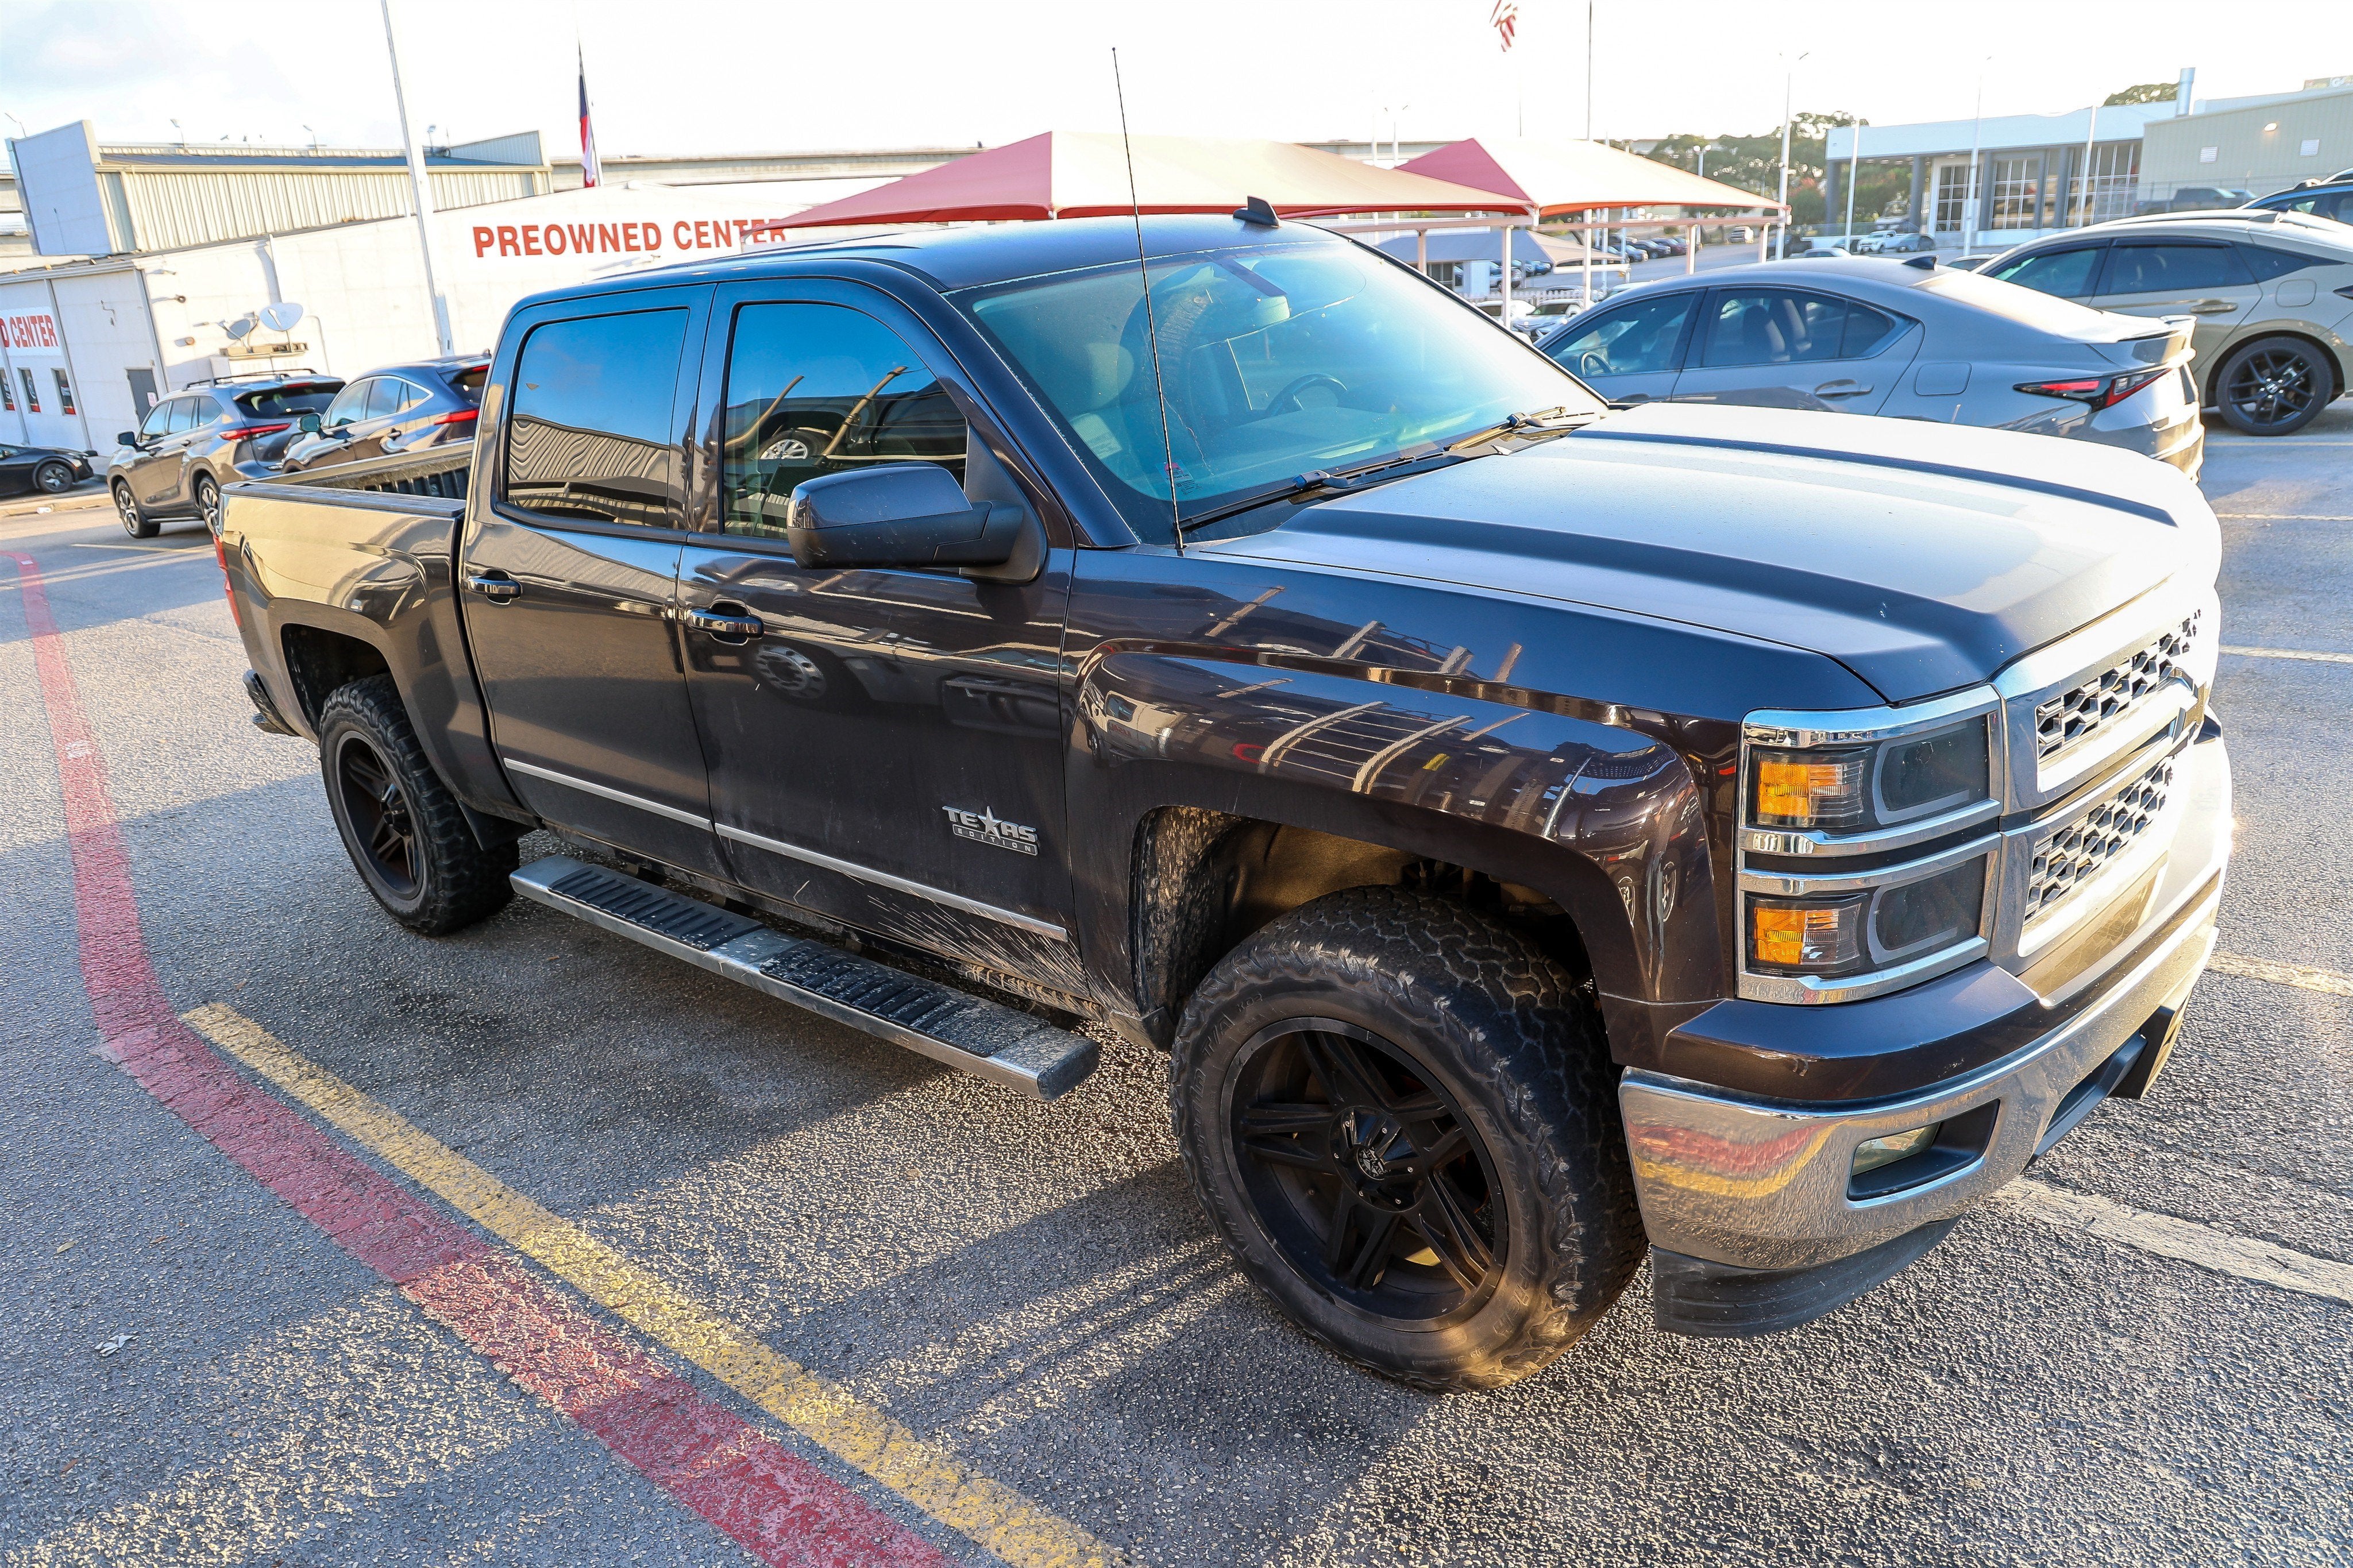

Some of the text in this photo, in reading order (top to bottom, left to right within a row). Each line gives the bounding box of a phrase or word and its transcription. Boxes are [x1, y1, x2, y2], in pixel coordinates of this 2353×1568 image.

[472, 222, 661, 258] PREOWNED
[9, 315, 59, 348] CENTER
[942, 806, 1038, 842] TEXAS
[958, 828, 1032, 852] EDITION
[1364, 1149, 1384, 1175] OUTLAW
